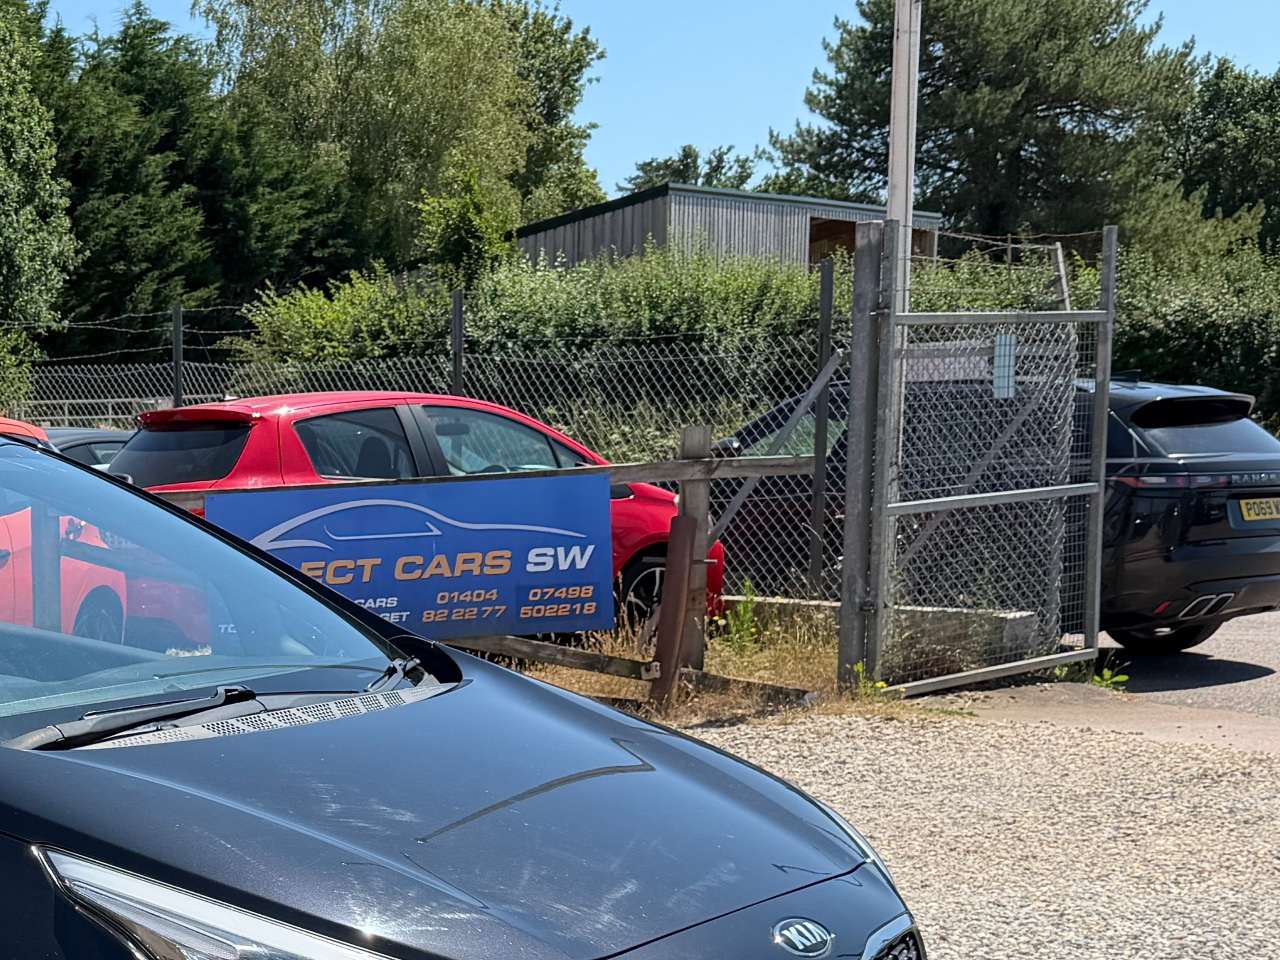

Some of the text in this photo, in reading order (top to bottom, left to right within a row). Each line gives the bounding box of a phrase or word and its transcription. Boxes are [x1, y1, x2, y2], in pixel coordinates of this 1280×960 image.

[301, 545, 595, 584] ECT CARS SW
[436, 589, 498, 604] 01404
[528, 585, 594, 601] 07498
[380, 611, 410, 622] GET
[520, 602, 597, 618] 502218
[781, 922, 826, 950] KIA
